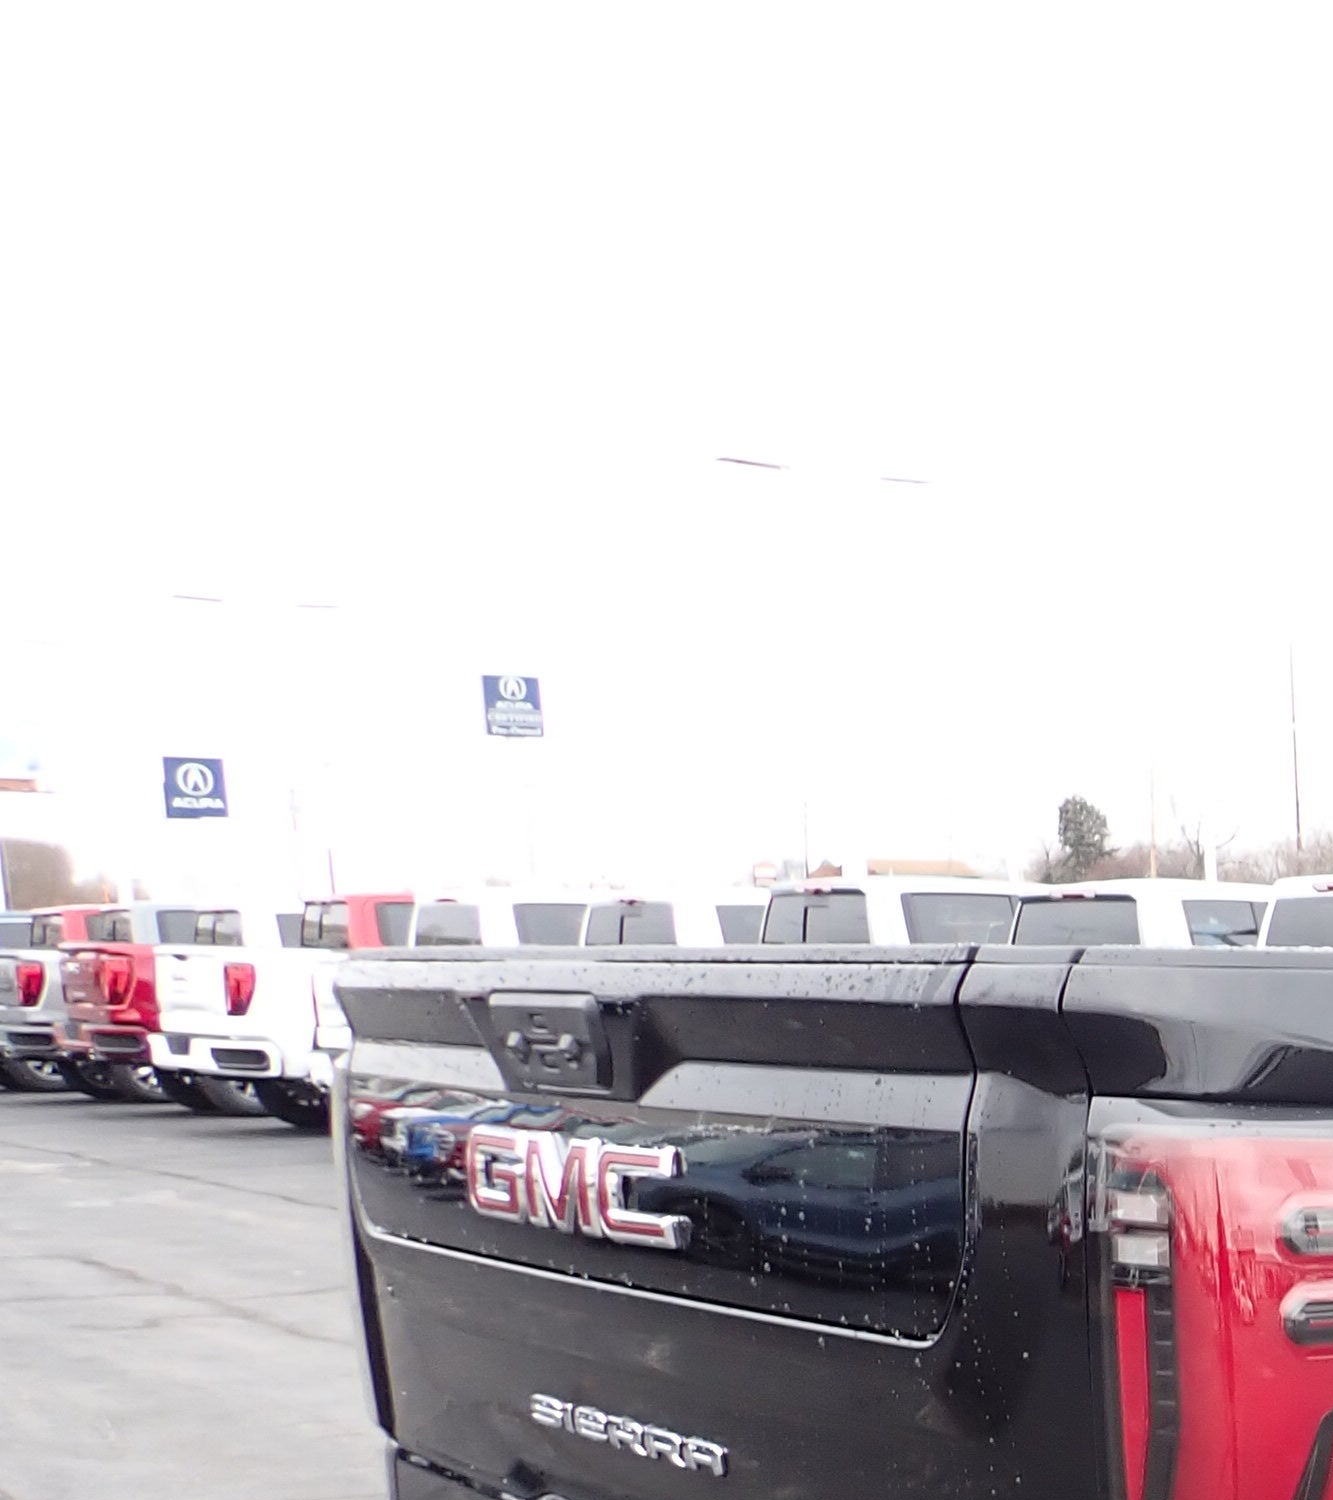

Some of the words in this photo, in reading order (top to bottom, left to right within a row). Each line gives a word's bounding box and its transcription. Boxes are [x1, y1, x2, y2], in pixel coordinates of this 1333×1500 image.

[172, 797, 225, 809] ACURA
[467, 1124, 690, 1249] GMC
[530, 1393, 727, 1477] SIERRA
